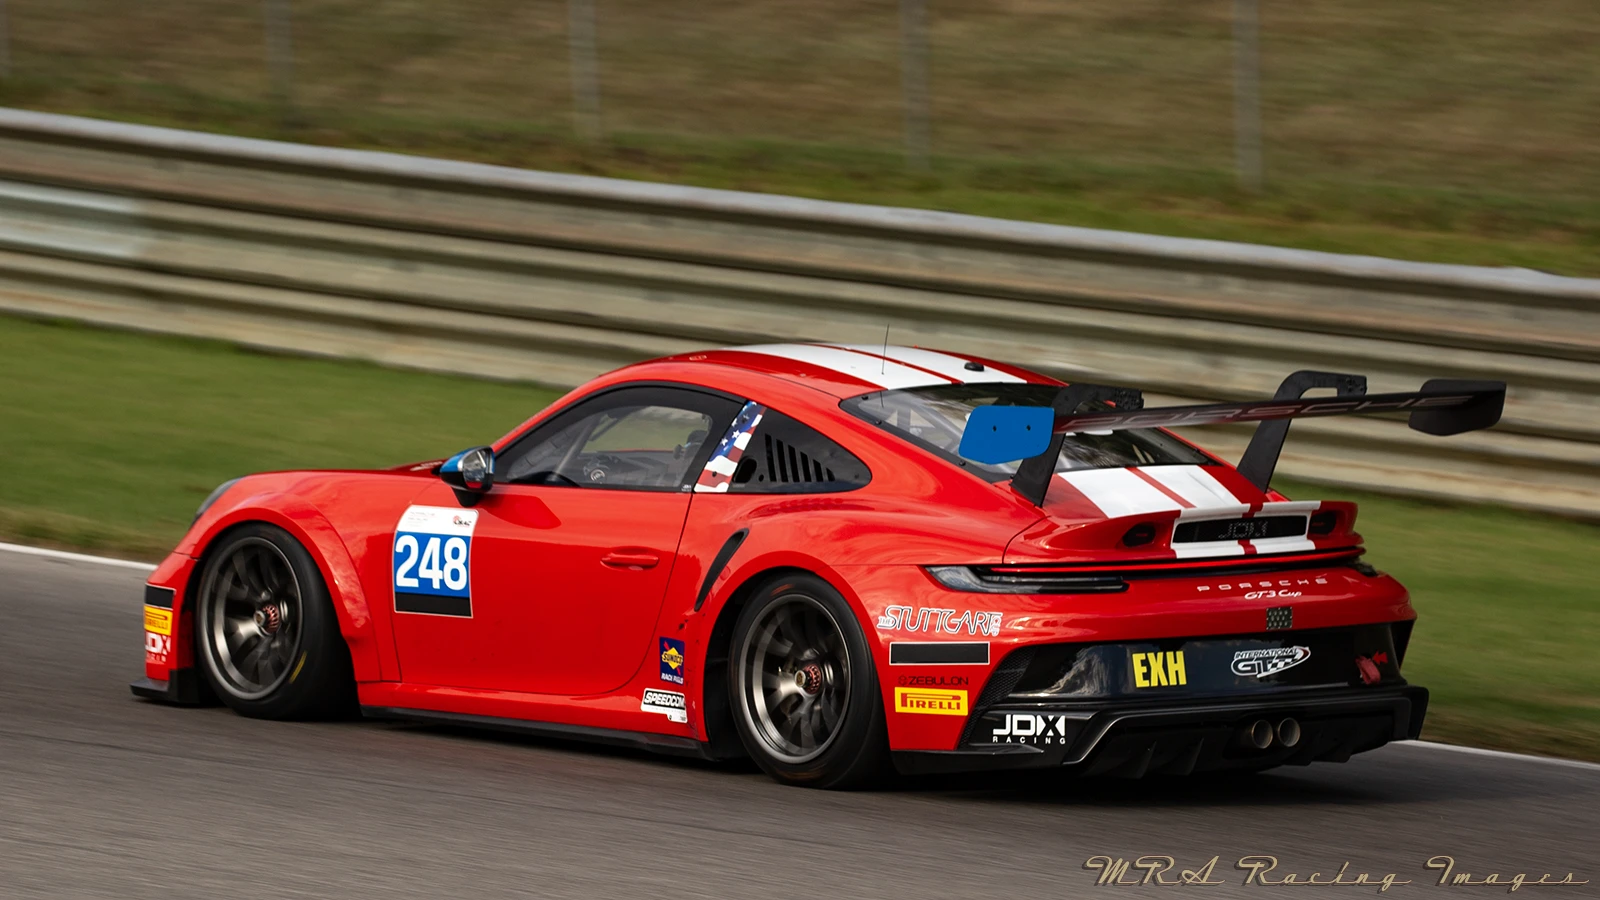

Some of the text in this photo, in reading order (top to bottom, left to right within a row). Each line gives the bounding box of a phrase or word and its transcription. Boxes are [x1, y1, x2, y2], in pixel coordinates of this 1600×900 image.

[1061, 395, 1475, 429] PORSCHE
[395, 534, 468, 591] 248
[1197, 577, 1328, 592] PORSCHE
[1278, 589, 1302, 599] Cup
[877, 605, 1003, 635] STUTTGART
[662, 652, 683, 665] SUNOCO
[1132, 650, 1187, 688] EXH
[908, 675, 969, 686] ZEBULON
[901, 692, 961, 711] PIRELLI
[993, 714, 1066, 736] JDX
[992, 736, 1066, 744] RACING
